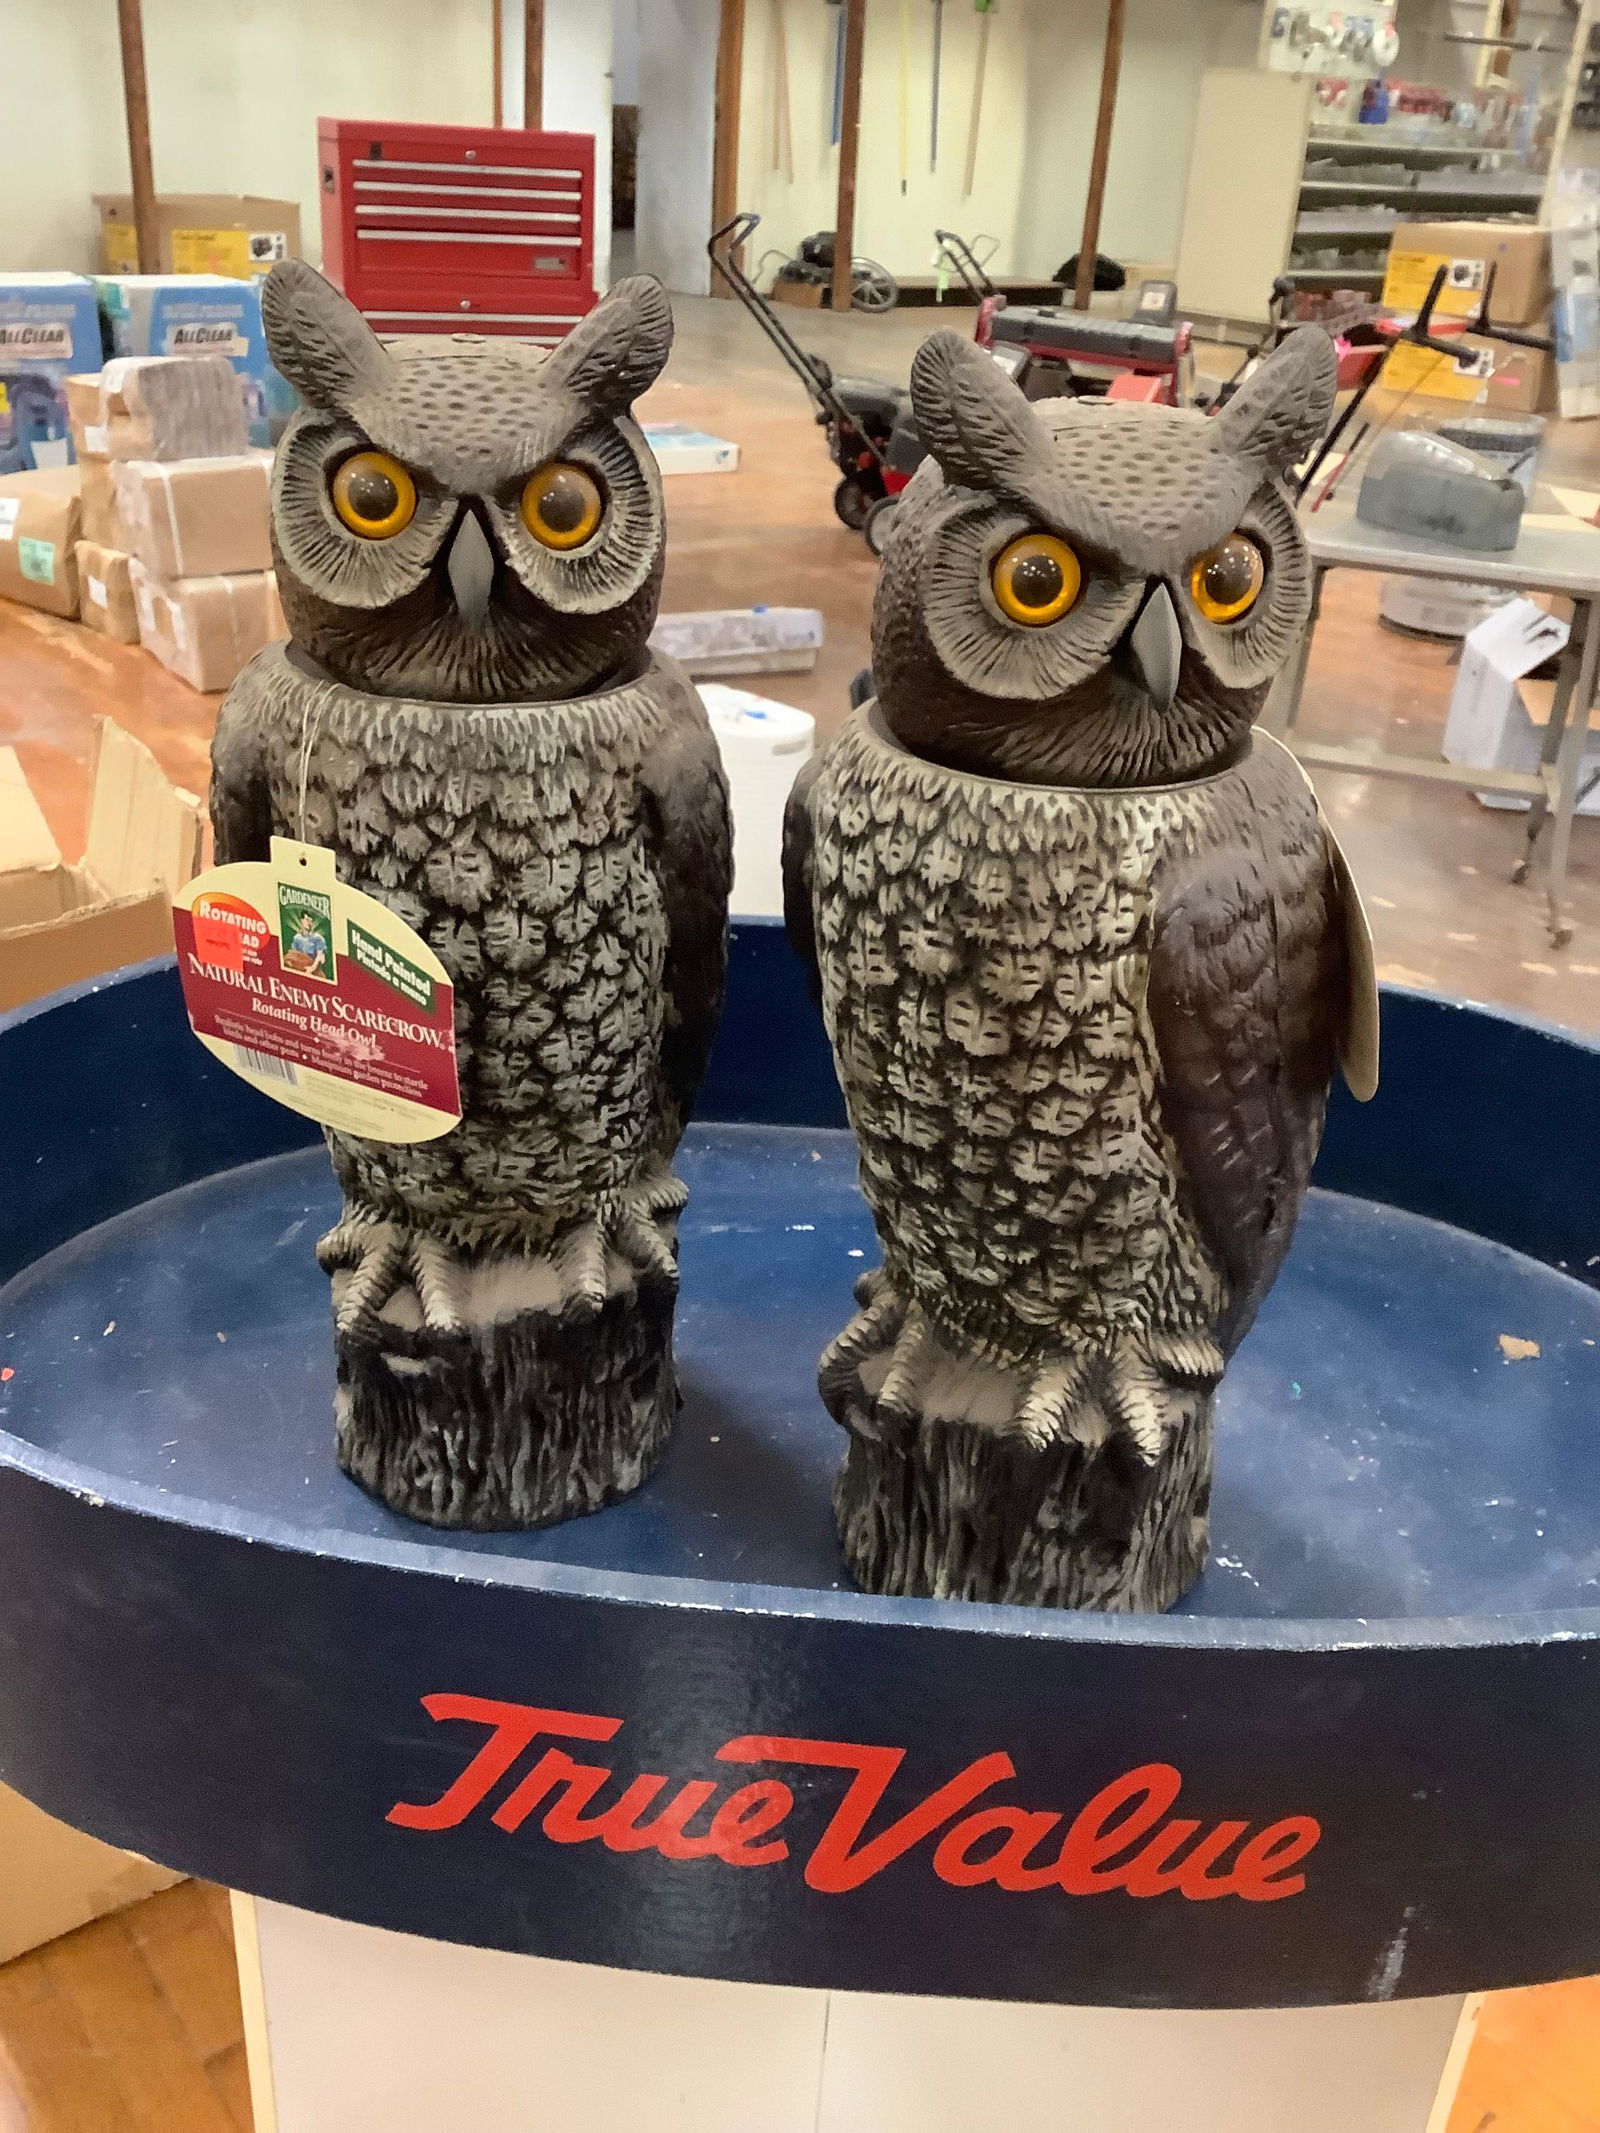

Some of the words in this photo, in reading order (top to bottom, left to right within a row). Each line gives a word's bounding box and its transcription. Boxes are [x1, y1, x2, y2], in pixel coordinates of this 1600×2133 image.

[200, 900, 267, 934] ROTATING
[280, 885, 330, 920] GARDENEER
[187, 952, 268, 996] NATURAL
[268, 976, 329, 1014] ENEMY
[352, 929, 382, 963] Hand
[385, 952, 430, 996] Painted
[357, 948, 391, 981] Pintado
[252, 997, 308, 1030] Rotating
[310, 1015, 345, 1036] Head
[348, 1028, 377, 1049] Owl
[385, 1693, 796, 1867] True
[715, 1735, 1322, 1901] Value
